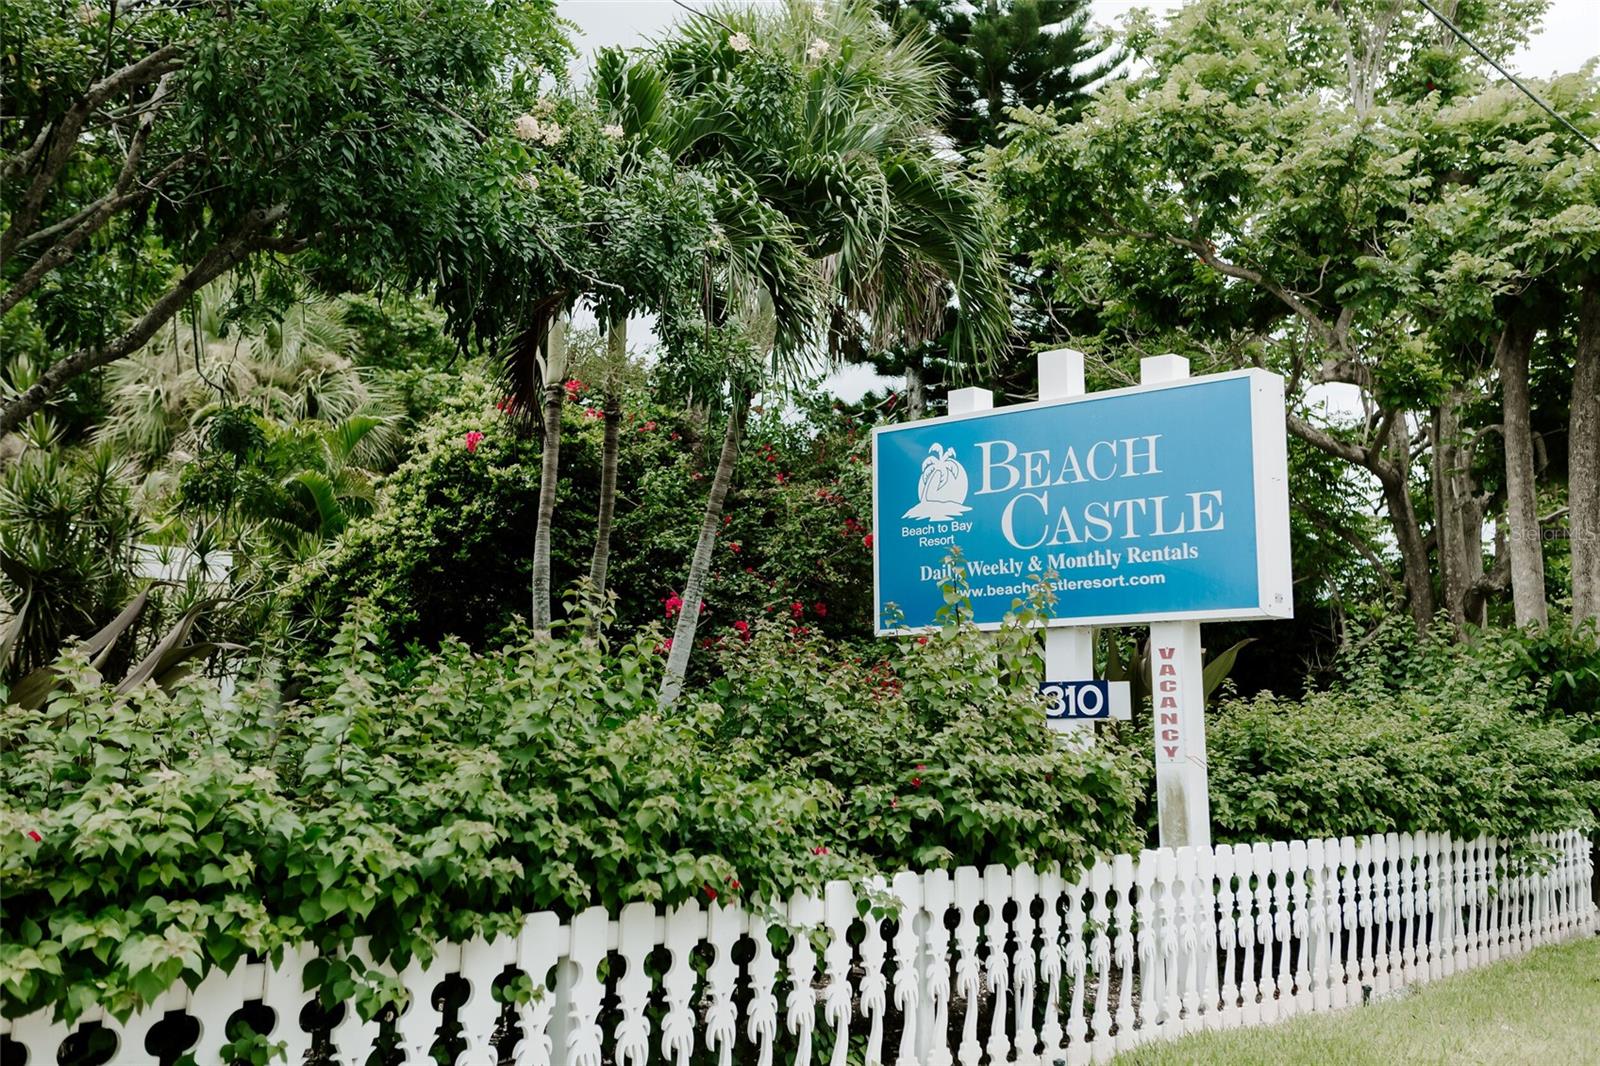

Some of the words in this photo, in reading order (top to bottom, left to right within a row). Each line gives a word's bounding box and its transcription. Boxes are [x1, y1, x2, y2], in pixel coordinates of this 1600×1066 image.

[973, 434, 1164, 496] BEACH
[901, 524, 935, 537] Beach
[938, 523, 949, 533] to
[951, 521, 973, 533] Bay
[1001, 490, 1225, 550] CASTLE
[919, 535, 955, 547] Resort
[967, 558, 1024, 577] Weekly
[1027, 555, 1043, 572] &
[1047, 549, 1122, 570] Monthly
[1127, 542, 1200, 564] Rentals
[950, 573, 1166, 599] ww.beachcstleresort.com
[1158, 647, 1179, 758] VACANCY
